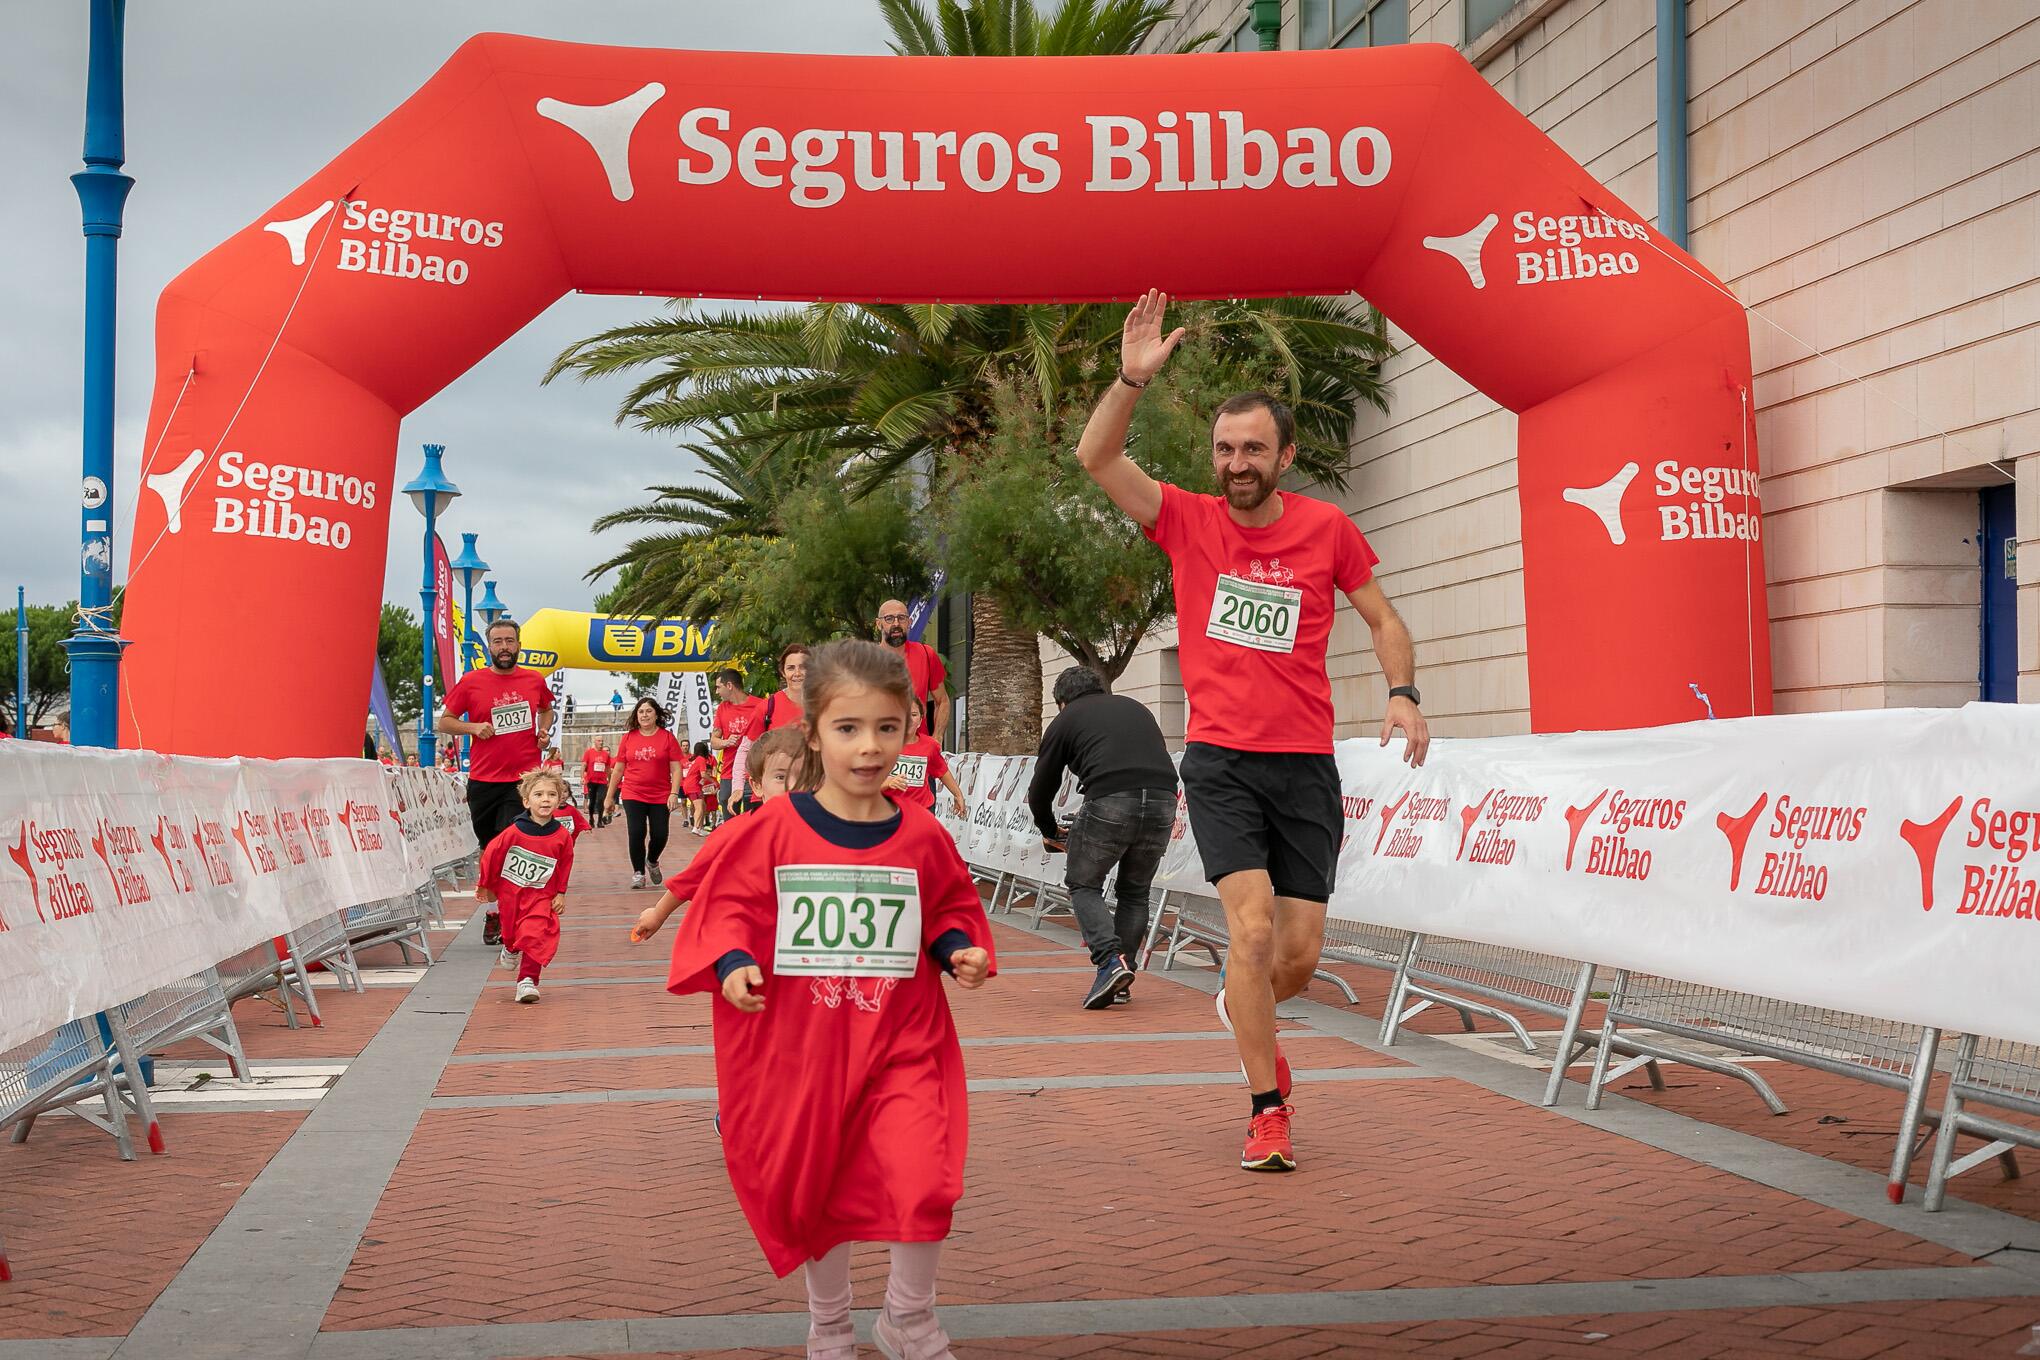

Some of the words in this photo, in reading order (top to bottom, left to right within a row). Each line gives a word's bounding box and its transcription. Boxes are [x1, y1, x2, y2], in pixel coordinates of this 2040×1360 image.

[678, 107, 1062, 208] Seguros
[1085, 110, 1393, 193] Bilbao
[342, 200, 504, 248] Seguros
[1512, 211, 1650, 247] Seguros
[336, 238, 469, 285] Bilbao
[1515, 247, 1640, 285] Bilbao
[216, 451, 376, 509] Seguros
[1655, 460, 1760, 503] Seguro
[212, 497, 351, 550] Bilbao
[1658, 502, 1760, 542] Bilbao
[1219, 595, 1290, 637] 2060
[528, 652, 555, 666] BM
[652, 624, 717, 657] BM
[496, 705, 528, 728] 2037
[890, 763, 924, 779] 2043
[350, 800, 381, 828] Seguros
[1341, 795, 1375, 820] uros
[1401, 791, 1452, 827] Seguros
[1486, 788, 1549, 828] Seguros
[1600, 789, 1687, 835] Seguros
[1769, 794, 1868, 850] Seguros
[29, 820, 84, 871] Seguros
[357, 828, 383, 852] Bilbao
[1384, 828, 1423, 859] Bilbao
[1469, 829, 1517, 866] Bilbao
[1585, 835, 1653, 881] Bilbao
[508, 855, 549, 882] 2037
[1754, 852, 1829, 901] Bilbao
[46, 873, 95, 921] Bilbao
[1956, 864, 2040, 921] Bilba
[791, 896, 906, 949] 2037
